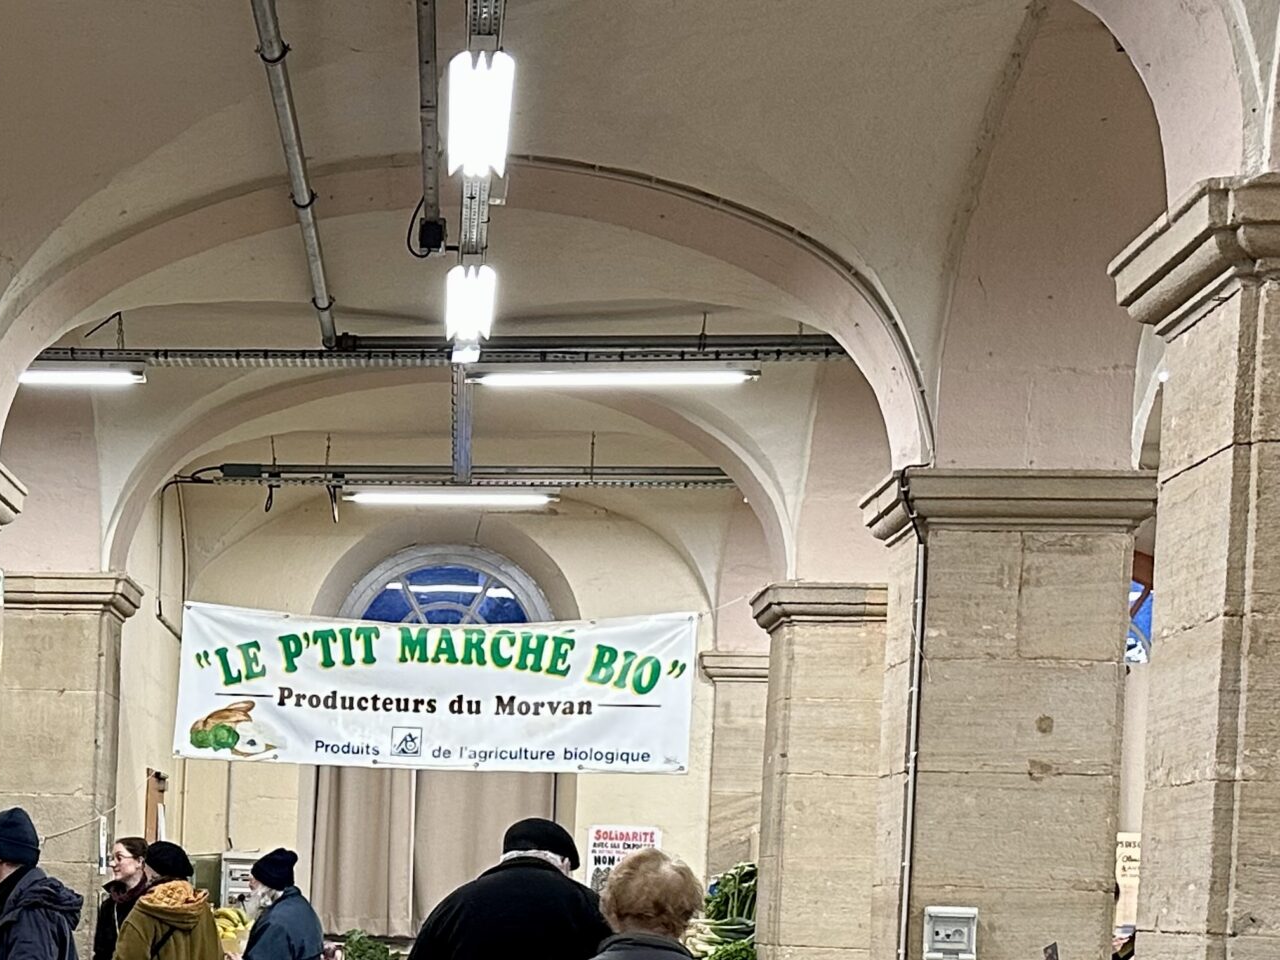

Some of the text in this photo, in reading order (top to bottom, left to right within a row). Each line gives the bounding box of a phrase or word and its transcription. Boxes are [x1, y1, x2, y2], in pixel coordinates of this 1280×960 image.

[277, 626, 381, 673] P'TIT
[398, 626, 576, 678] MARCHÉ
[277, 687, 593, 716] Producteurs du Morvan
[314, 740, 380, 756] Produits
[431, 745, 452, 759] de
[459, 746, 555, 762] l'agriculture
[563, 747, 651, 763] biologique
[593, 855, 615, 866] NON
